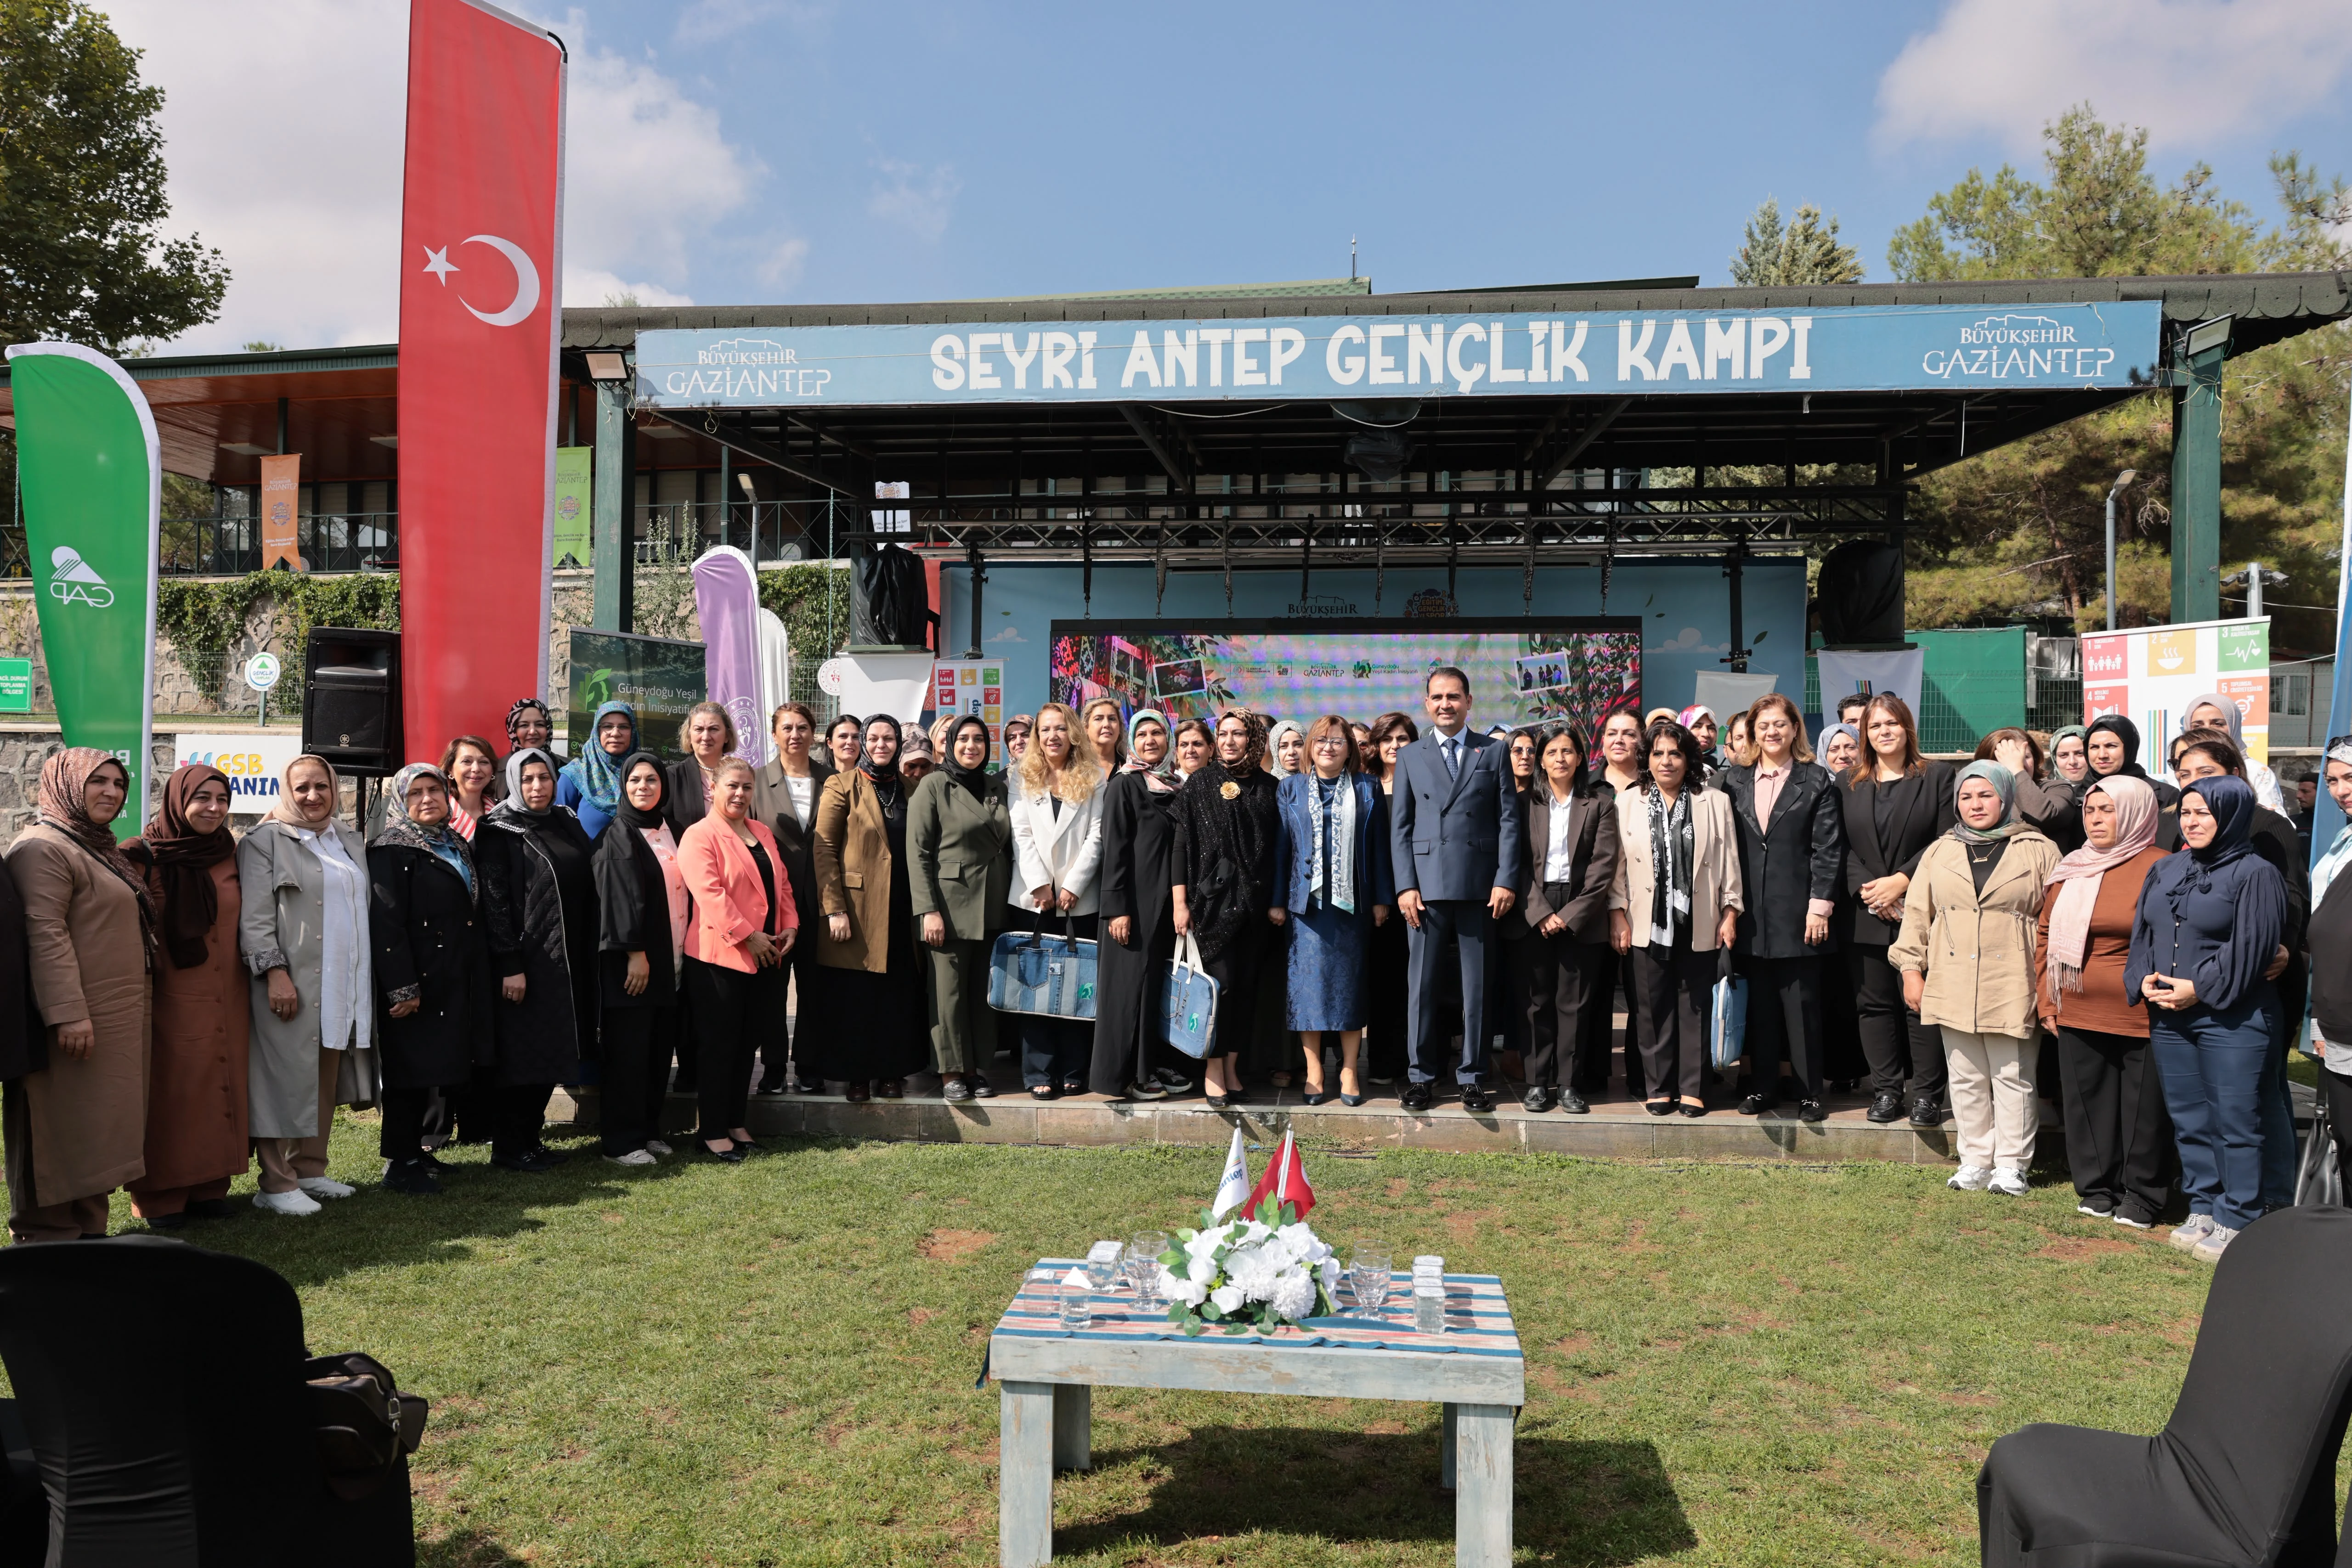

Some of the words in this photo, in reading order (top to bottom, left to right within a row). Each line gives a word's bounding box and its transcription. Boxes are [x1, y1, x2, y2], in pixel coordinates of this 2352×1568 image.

[1960, 326, 2078, 346] BÜYÜKŞEHİR
[697, 349, 800, 367] BÜYÜKŞEHİR
[1121, 327, 1306, 388] ANTEP
[1326, 320, 1589, 394] GENÇLİK
[1617, 316, 1813, 381] KAMPI
[1922, 345, 2115, 378] GAZİANTEP
[667, 367, 831, 398] GAZİANTEP
[1288, 604, 1358, 615] BÜYÜKŞEHİR
[2152, 634, 2157, 644] 2
[2222, 627, 2228, 637] 3
[2087, 640, 2091, 650] 1
[618, 683, 673, 699] Güneydoğu
[676, 688, 697, 702] Yeşil
[2087, 691, 2092, 701] 4
[2222, 682, 2228, 693] 5
[648, 699, 690, 716] İnisiyatifi
[1218, 1168, 1243, 1193] antep
